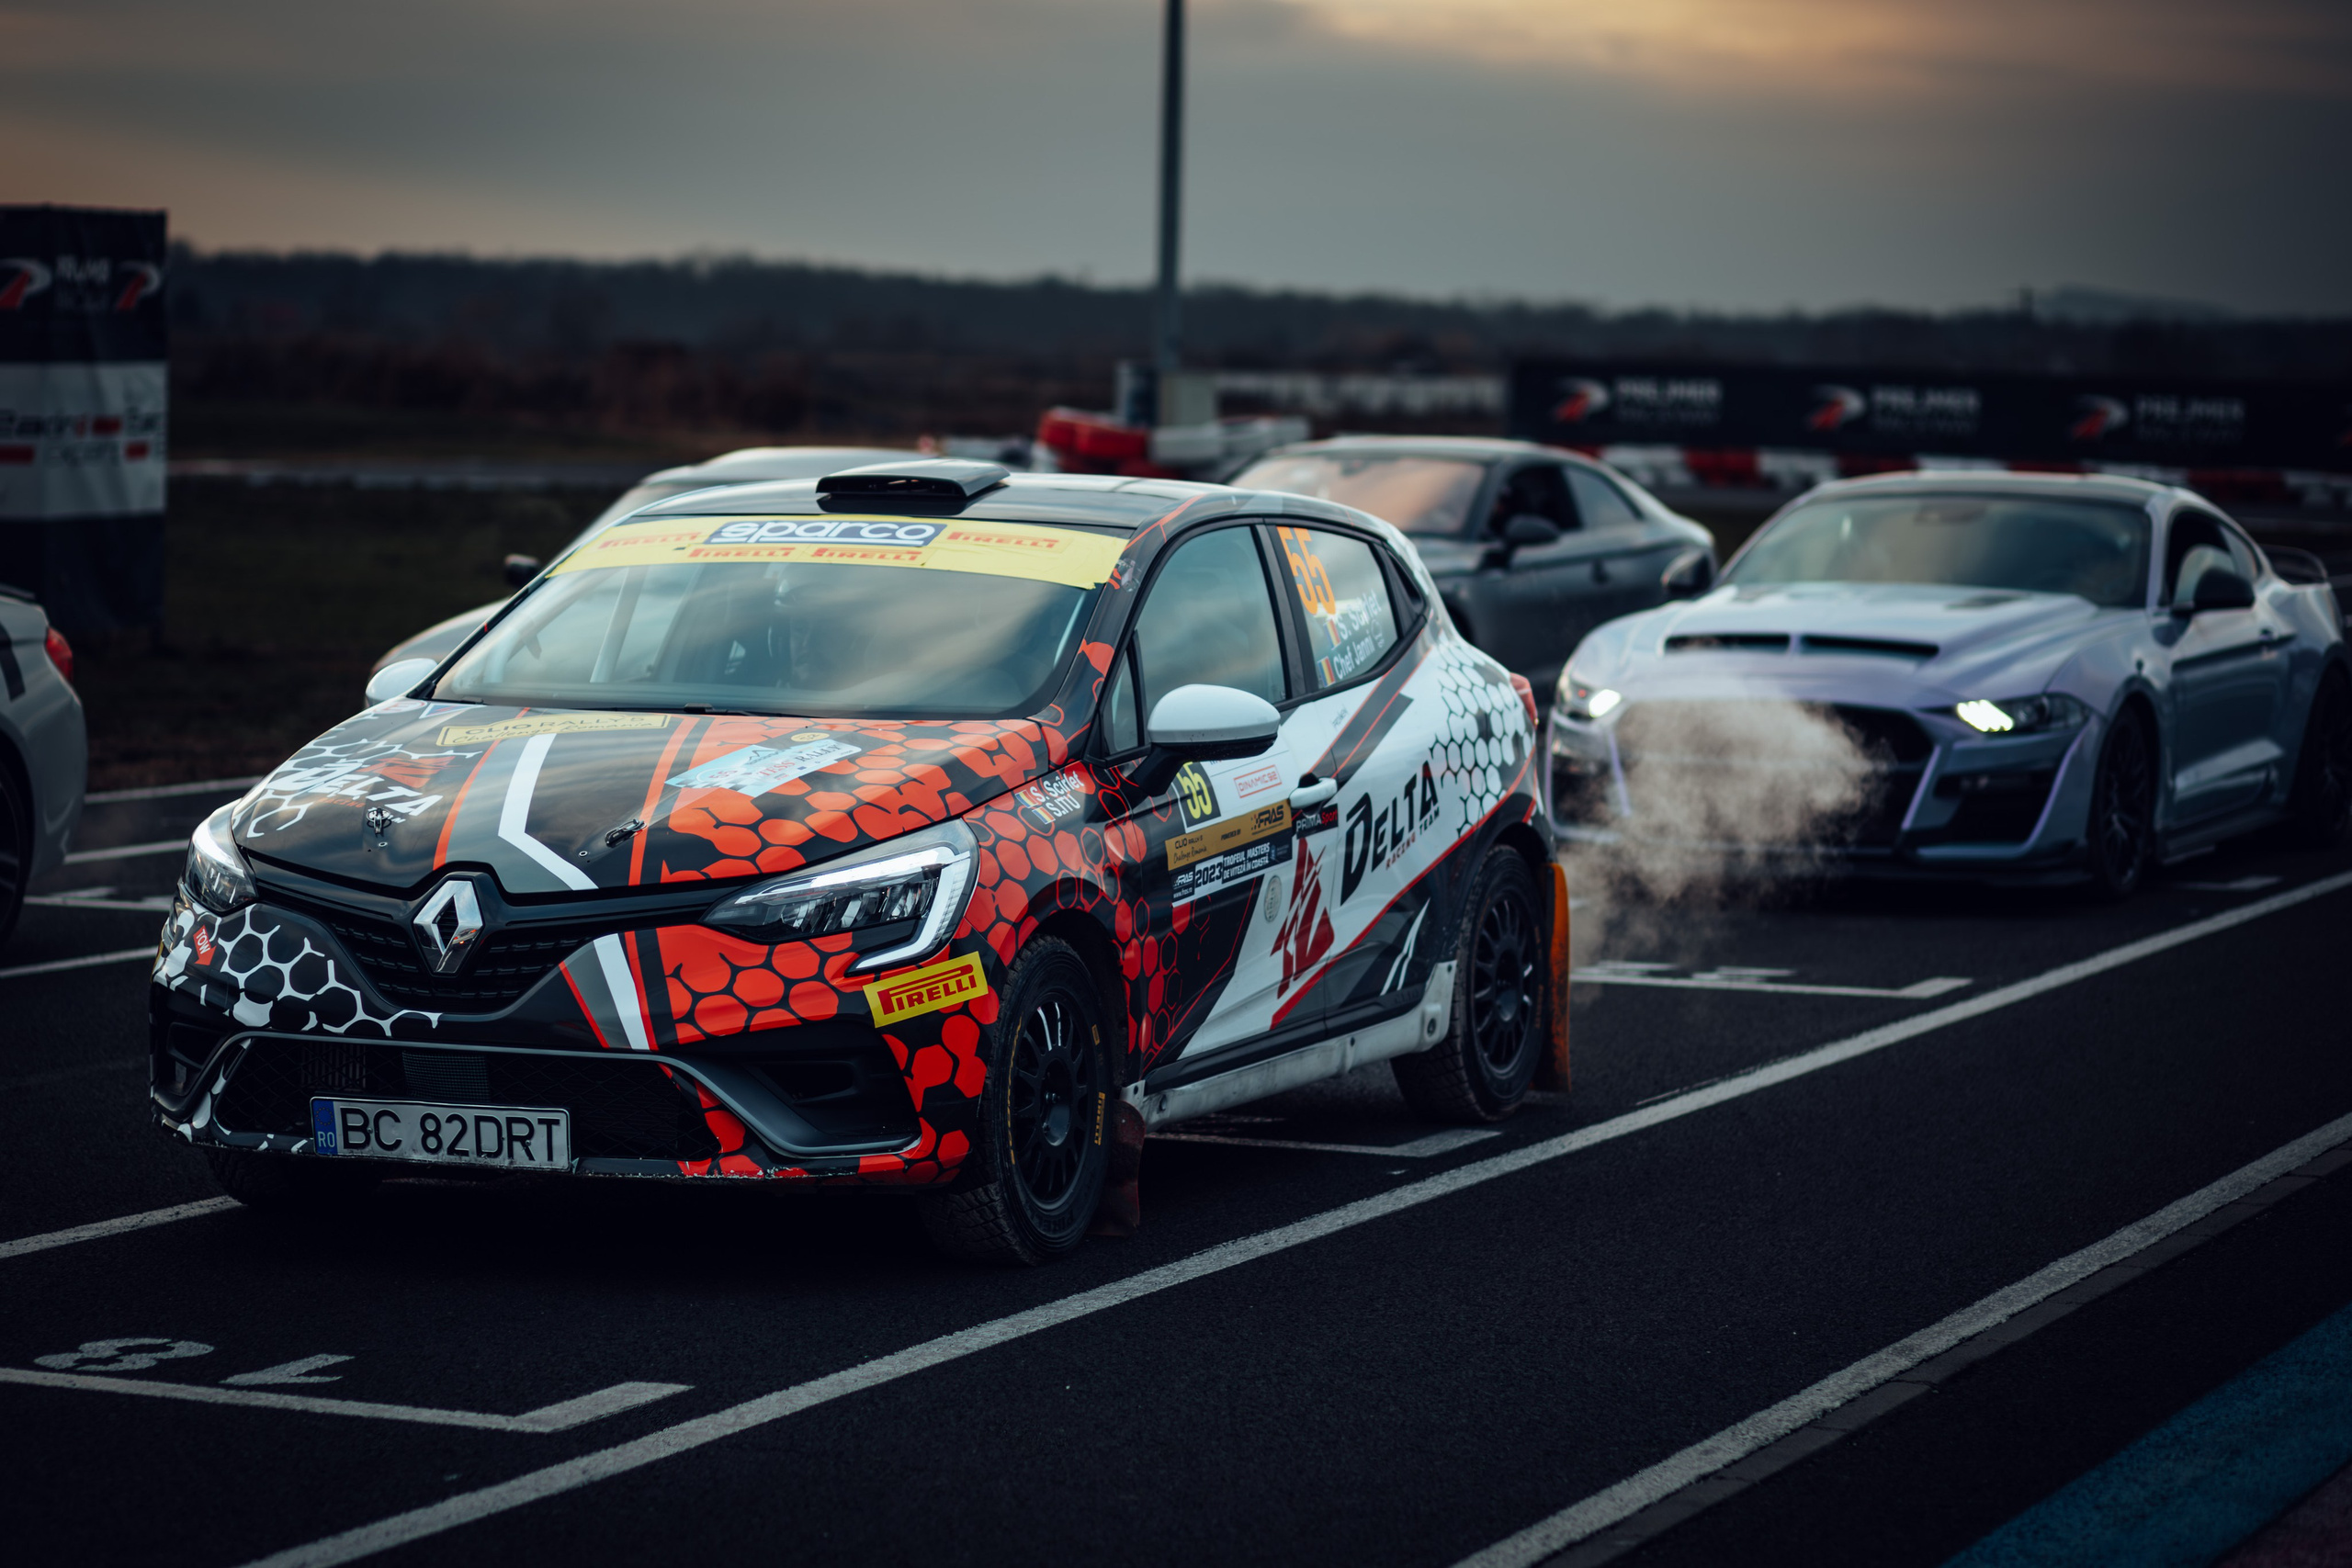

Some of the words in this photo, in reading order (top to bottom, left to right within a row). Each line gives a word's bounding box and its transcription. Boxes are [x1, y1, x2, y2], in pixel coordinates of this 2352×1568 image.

[598, 532, 702, 549] PIRELLI
[719, 521, 935, 543] sparco
[947, 531, 1059, 548] PIRELLI
[689, 547, 796, 558] PIRELLI
[811, 547, 922, 561] PIRELLI
[1276, 525, 1336, 615] 55
[1333, 646, 1355, 680] Chef
[465, 723, 532, 735] CLIO
[795, 744, 842, 762] RALLY
[265, 760, 444, 817] DELTA
[1029, 785, 1050, 803] S.
[1043, 770, 1084, 797] Scîrlet
[1176, 761, 1213, 819] 55
[1174, 837, 1188, 850] CLIO
[1255, 804, 1284, 829] FRAS
[1340, 760, 1439, 908] DELTA
[1385, 830, 1417, 871] RACING
[1419, 805, 1441, 836] TEAM
[1223, 851, 1246, 867] TROFEUL
[1246, 842, 1271, 859] MASTERS
[1194, 862, 1224, 888] 2023
[196, 928, 211, 954] TOW
[876, 964, 978, 1016] PIRELLI
[317, 1131, 336, 1148] RO
[339, 1106, 403, 1153] BC
[419, 1112, 561, 1162] 82DRT
